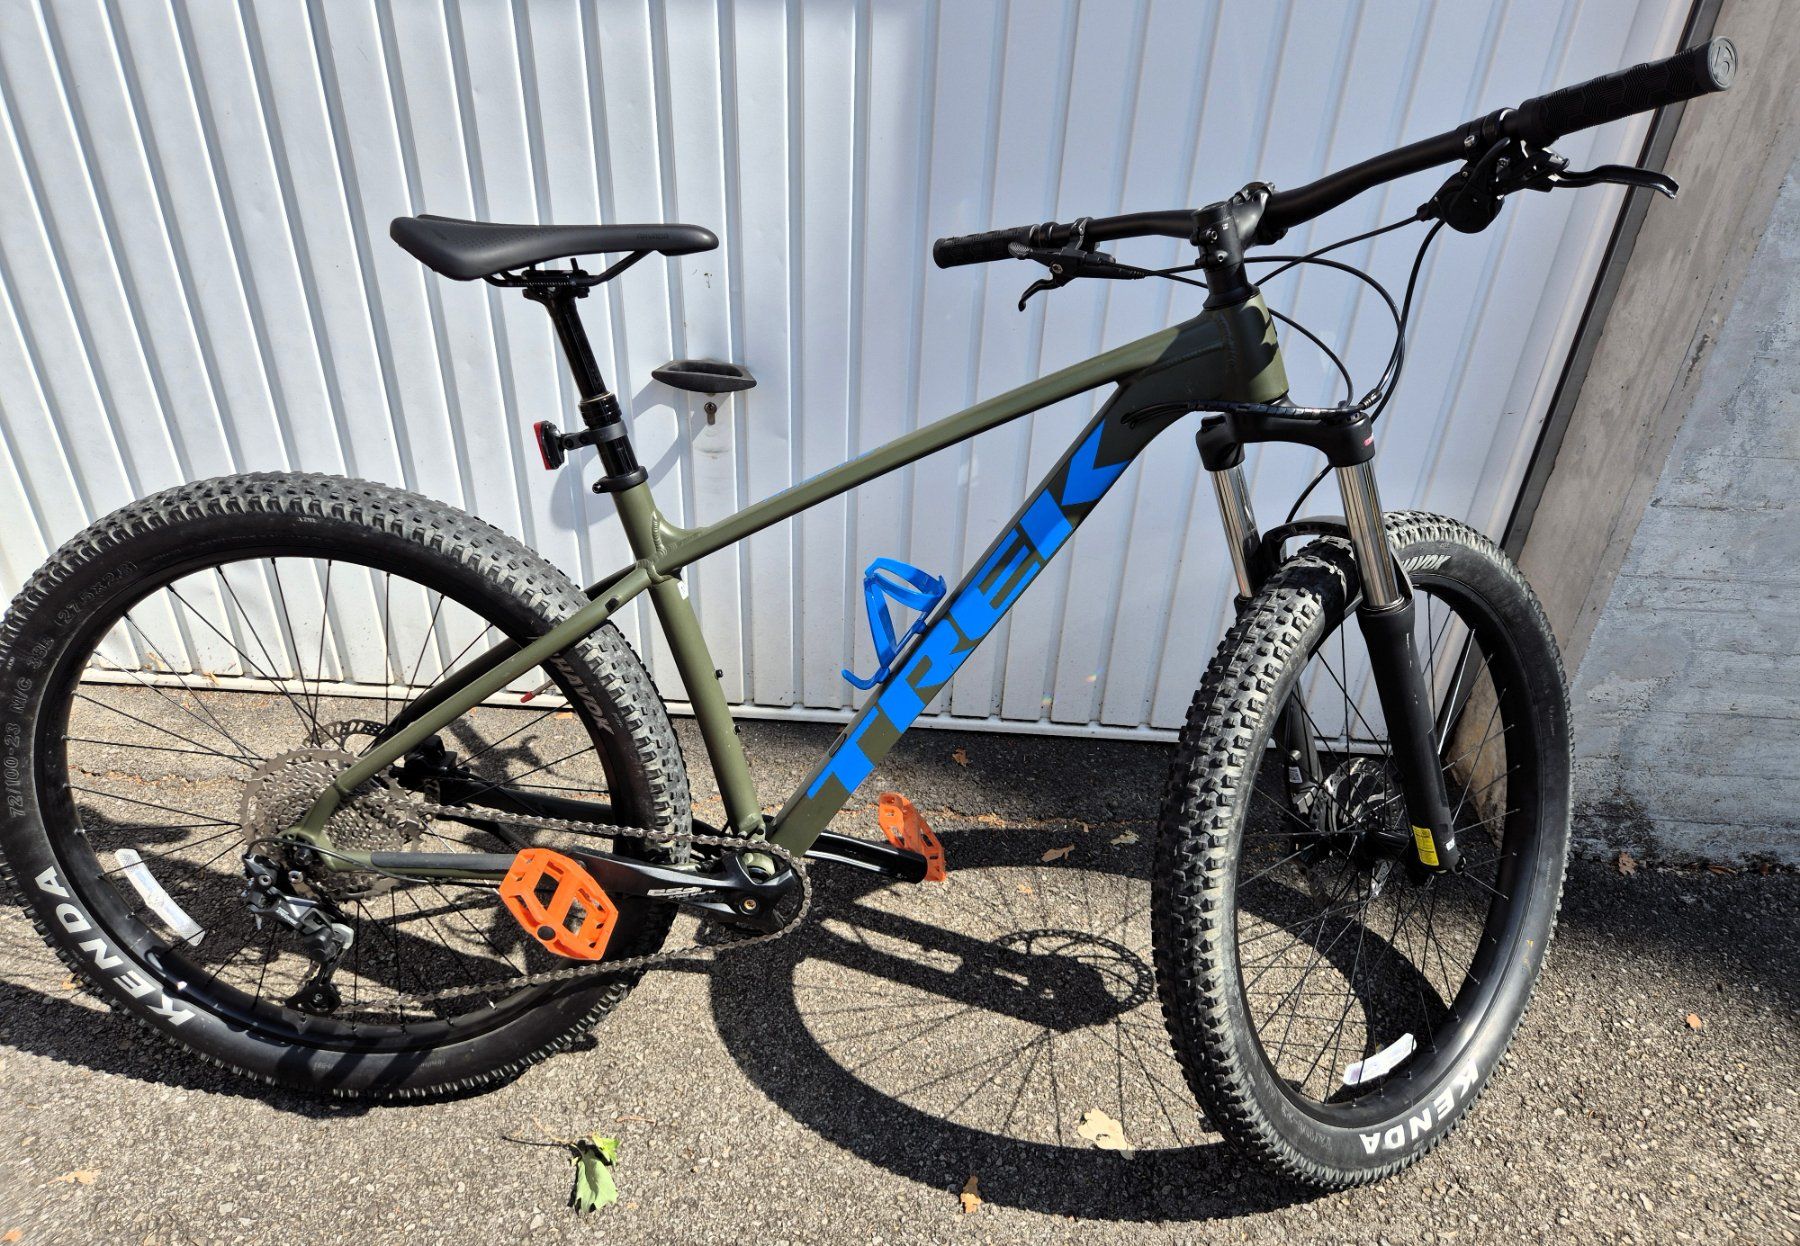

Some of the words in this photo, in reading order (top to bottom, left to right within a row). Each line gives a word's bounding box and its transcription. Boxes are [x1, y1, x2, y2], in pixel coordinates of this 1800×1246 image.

[807, 418, 1132, 799] TREK
[9, 676, 33, 714] M/C
[4, 722, 25, 818] 72/100-23
[34, 865, 196, 1026] KENDA
[1359, 1058, 1480, 1154] KENDA
